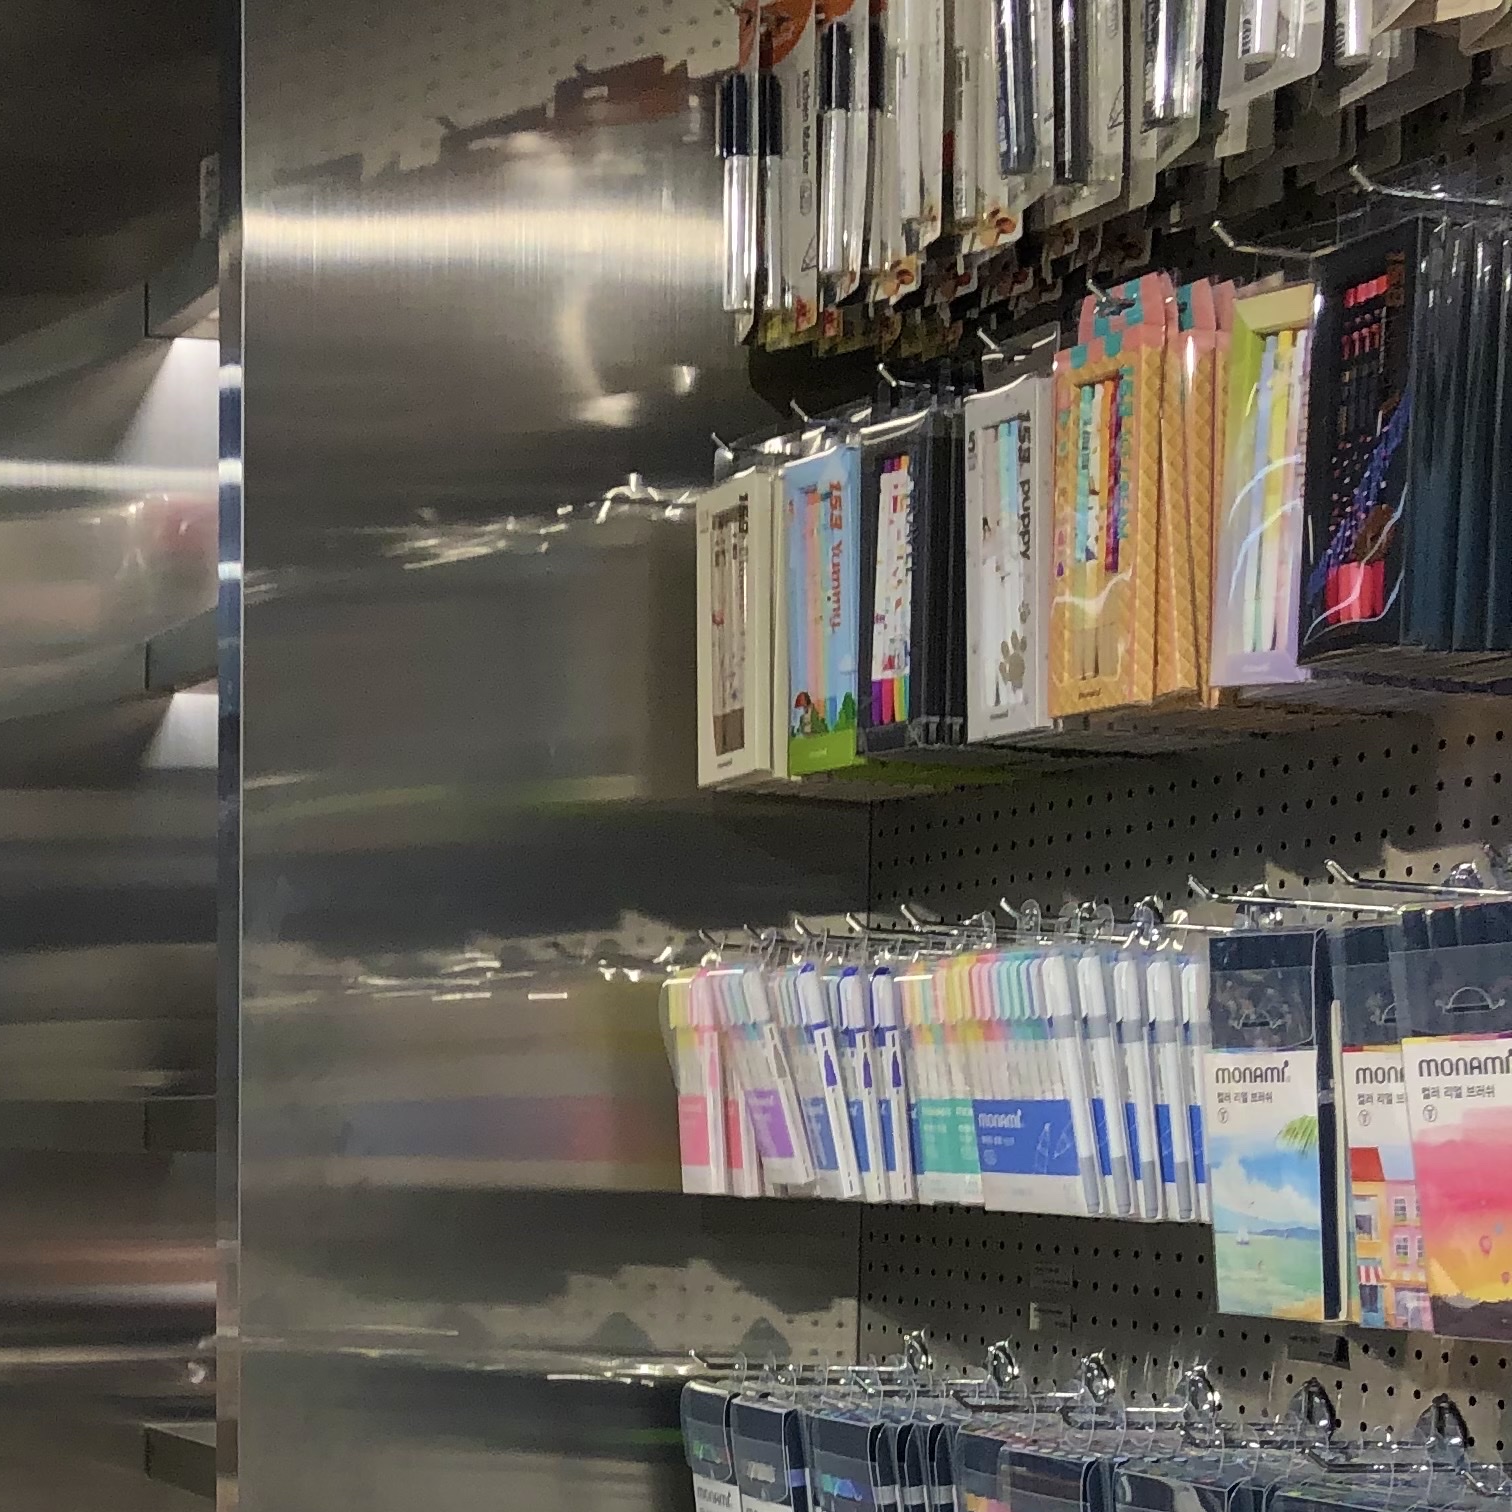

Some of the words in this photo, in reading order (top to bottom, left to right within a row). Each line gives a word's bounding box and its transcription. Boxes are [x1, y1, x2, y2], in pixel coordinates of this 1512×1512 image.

[1018, 410, 1032, 464] 153
[829, 481, 842, 530] 153
[1019, 479, 1032, 560] puppy
[829, 539, 842, 634] Yummy
[1356, 1066, 1405, 1085] mon
